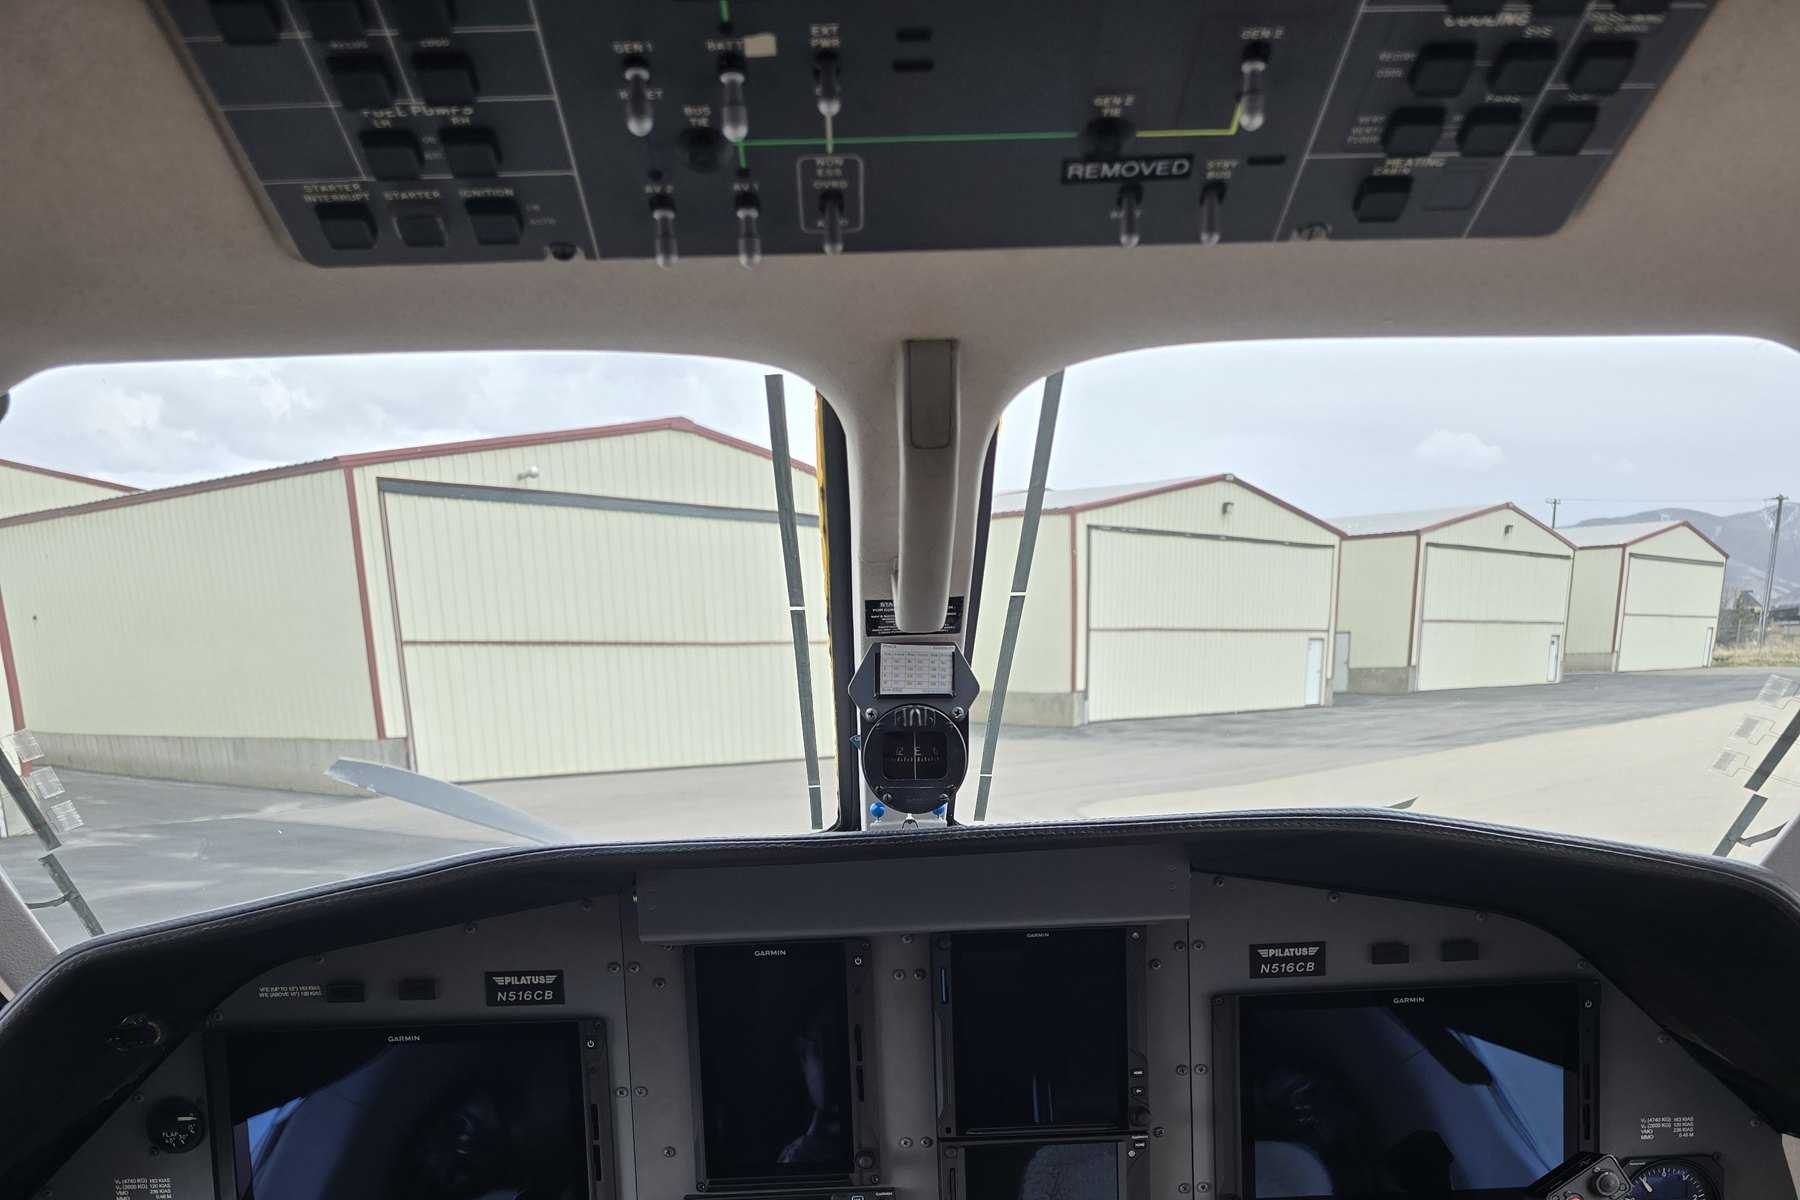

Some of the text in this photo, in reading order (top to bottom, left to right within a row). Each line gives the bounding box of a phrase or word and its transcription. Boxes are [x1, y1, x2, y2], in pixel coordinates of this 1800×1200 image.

[810, 24, 839, 36] EXT
[1240, 27, 1271, 38] GEN
[613, 41, 644, 53] GEN
[706, 39, 745, 52] BATT
[810, 36, 840, 47] PWR
[682, 105, 711, 116] BUS
[689, 116, 711, 127] TIE
[1205, 158, 1239, 169] STBY
[1385, 157, 1447, 168] HEATING
[1066, 158, 1190, 180] REMOVED
[304, 182, 361, 193] STARTER
[458, 187, 515, 198] IGNITION
[384, 190, 440, 201] STARTER
[755, 949, 787, 957] GARMIN
[1268, 946, 1308, 958] PILATUS
[1260, 961, 1316, 974] N516CB
[504, 975, 546, 985] PILATUS
[497, 990, 553, 1001] N516CB
[1393, 996, 1425, 1004] GARMIN
[388, 1034, 421, 1042] GARMIN
